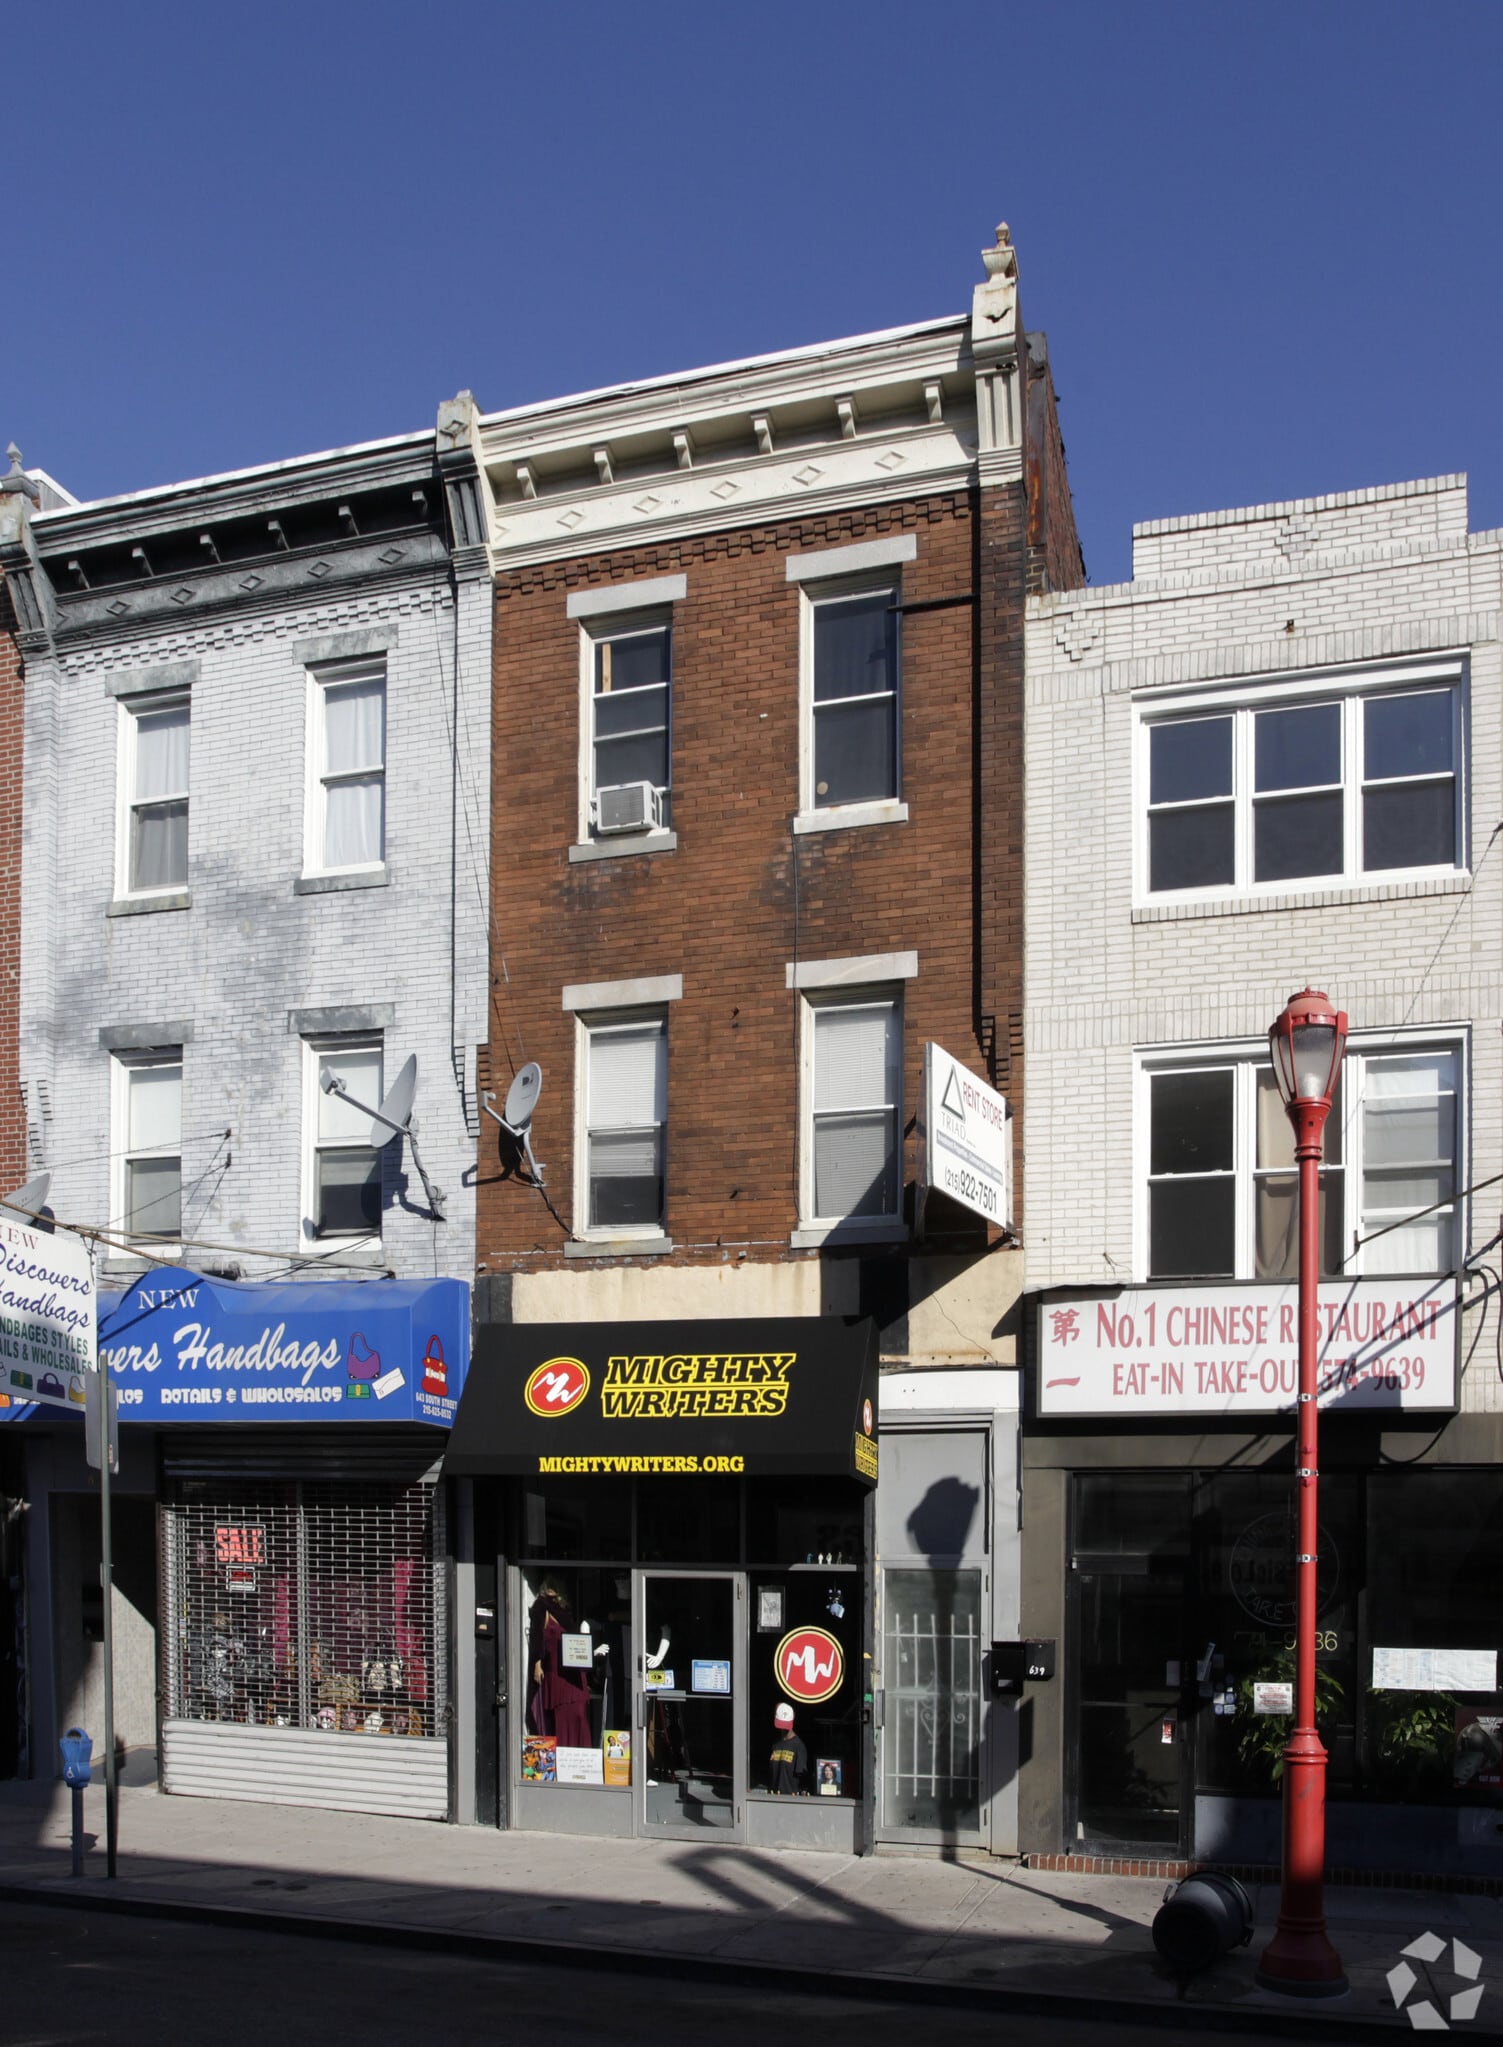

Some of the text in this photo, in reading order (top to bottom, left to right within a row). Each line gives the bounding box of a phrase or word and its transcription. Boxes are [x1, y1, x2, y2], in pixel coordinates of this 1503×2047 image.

[963, 1080, 1003, 1132] RENT STORE
[941, 1111, 966, 1142] TRIAD
[0, 1224, 39, 1250] EW
[0, 1281, 91, 1334] andbags
[138, 1288, 199, 1310] NEW
[1096, 1300, 1441, 1348] No.1 CHINESE RSTAURANT
[51, 1329, 89, 1357] STYLES
[173, 1322, 342, 1387] Handbags
[605, 1353, 797, 1387] MIGHTY
[1112, 1355, 1426, 1396] EAT-IN TAKE-OU 574-9639
[601, 1387, 789, 1418] WRITERS
[538, 1455, 745, 1473] MIGHTYWRITERS.ORG
[1029, 1664, 1046, 1676] 639
